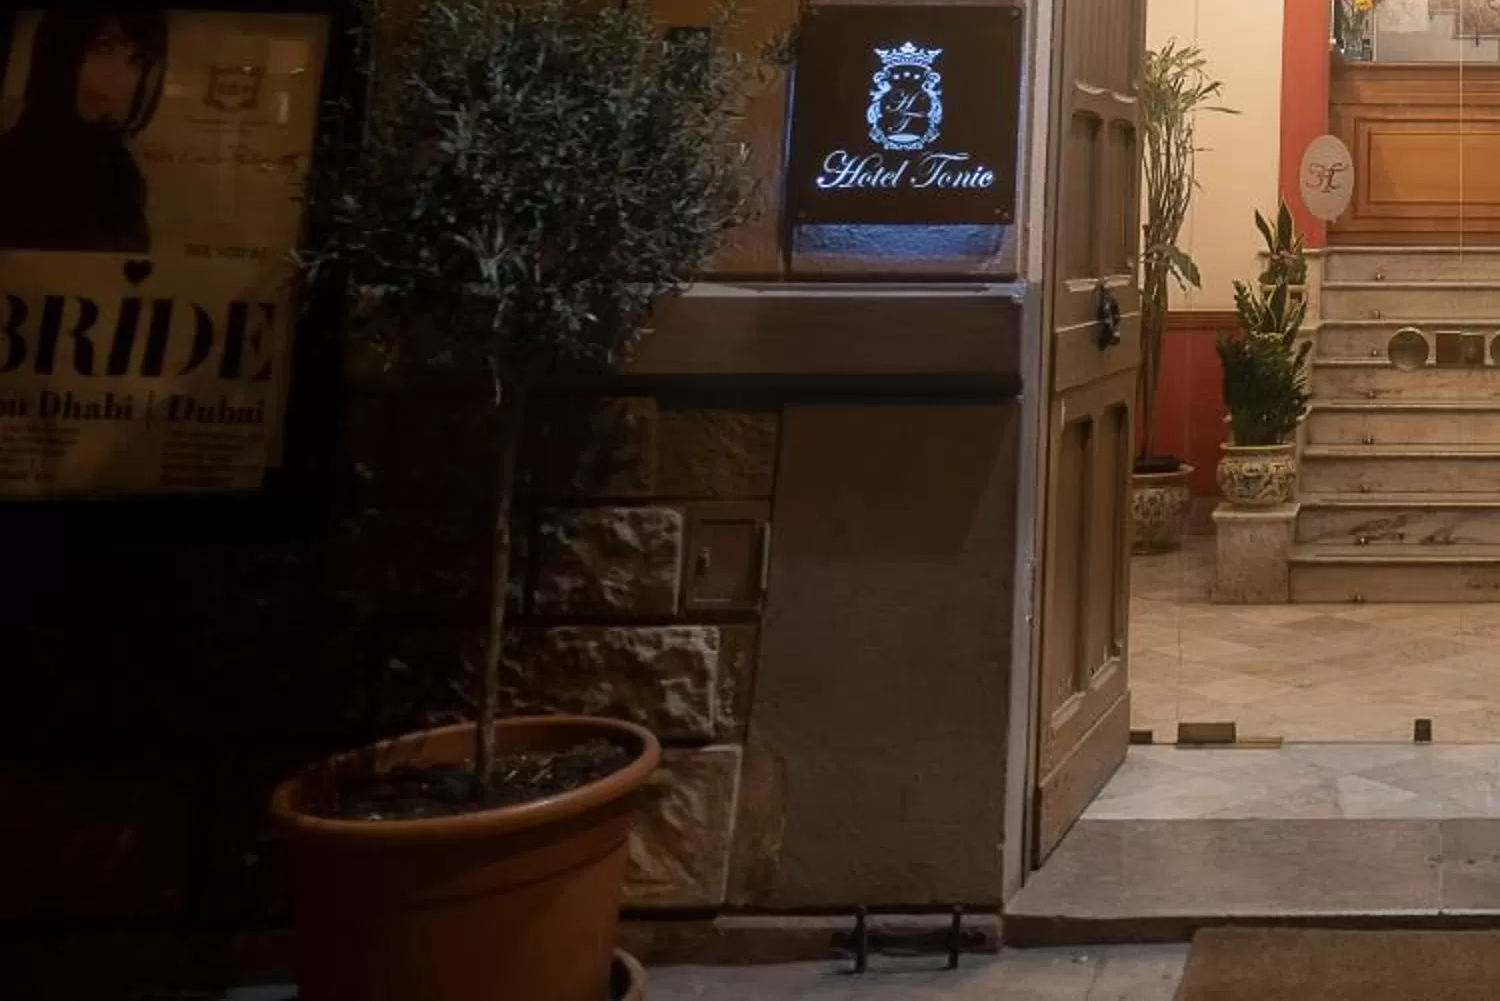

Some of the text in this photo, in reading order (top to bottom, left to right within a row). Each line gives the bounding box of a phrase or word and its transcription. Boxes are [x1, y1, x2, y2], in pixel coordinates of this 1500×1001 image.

[816, 150, 995, 188] Hotel Tonic
[39, 390, 133, 420] Dhabi
[167, 395, 265, 424] Dubai
